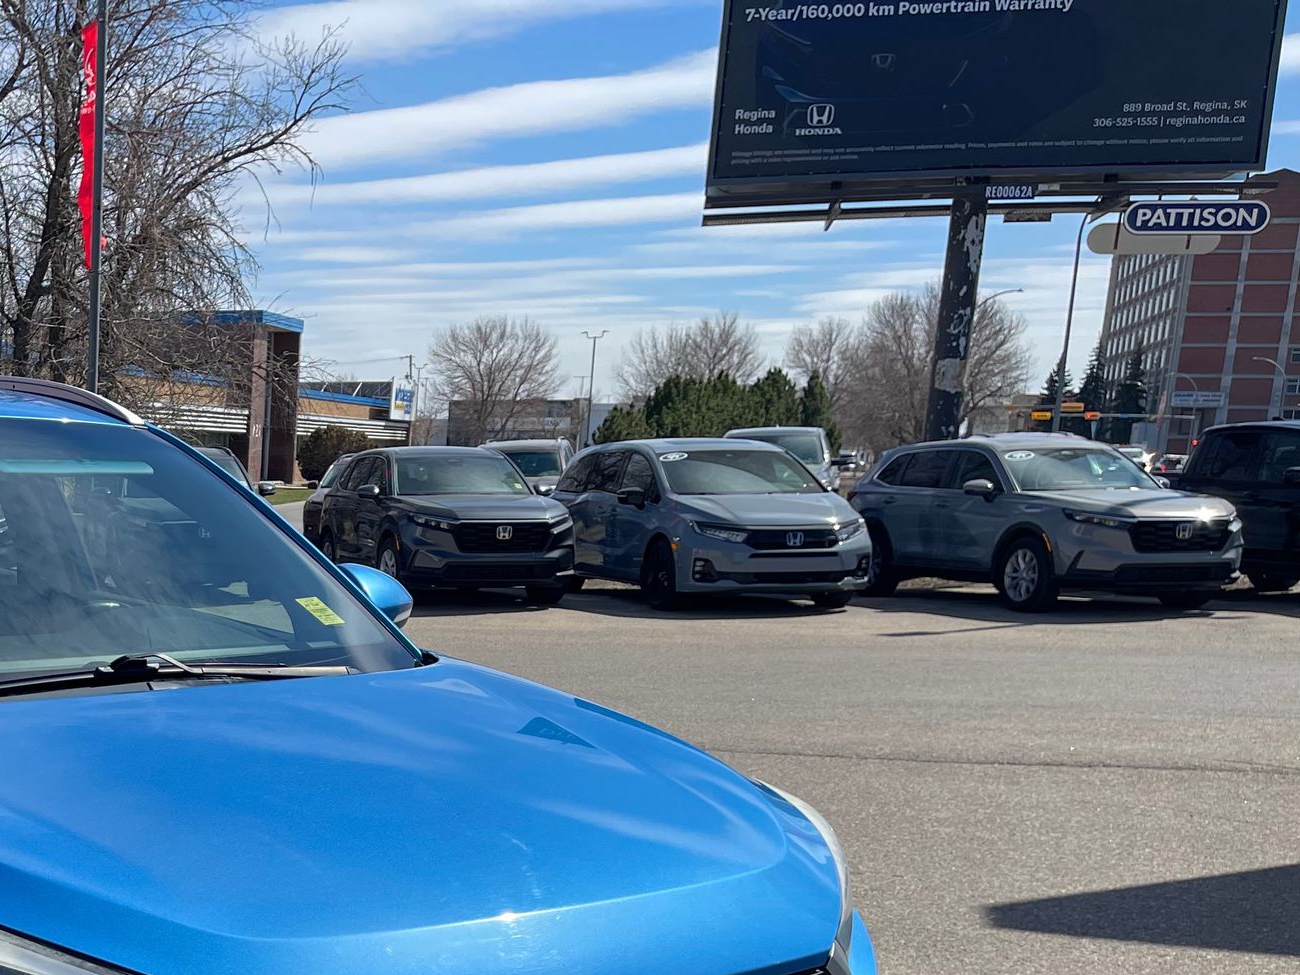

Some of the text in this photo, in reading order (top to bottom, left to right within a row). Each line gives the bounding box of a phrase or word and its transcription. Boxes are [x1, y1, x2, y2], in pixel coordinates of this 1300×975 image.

[745, 3, 865, 22] 7-Year/160,000
[868, 2, 894, 16] km
[898, 0, 990, 15] Powertrain
[1122, 103, 1142, 112] 889
[1144, 102, 1174, 112] Broad
[1233, 100, 1247, 109] SK
[735, 108, 776, 122] Regina
[1093, 117, 1158, 127] 306-525-1555
[1166, 115, 1245, 128] reginahonda.ca
[734, 123, 773, 135] Honda
[795, 127, 842, 136] HONDA
[1135, 207, 1258, 227] PATTISON
